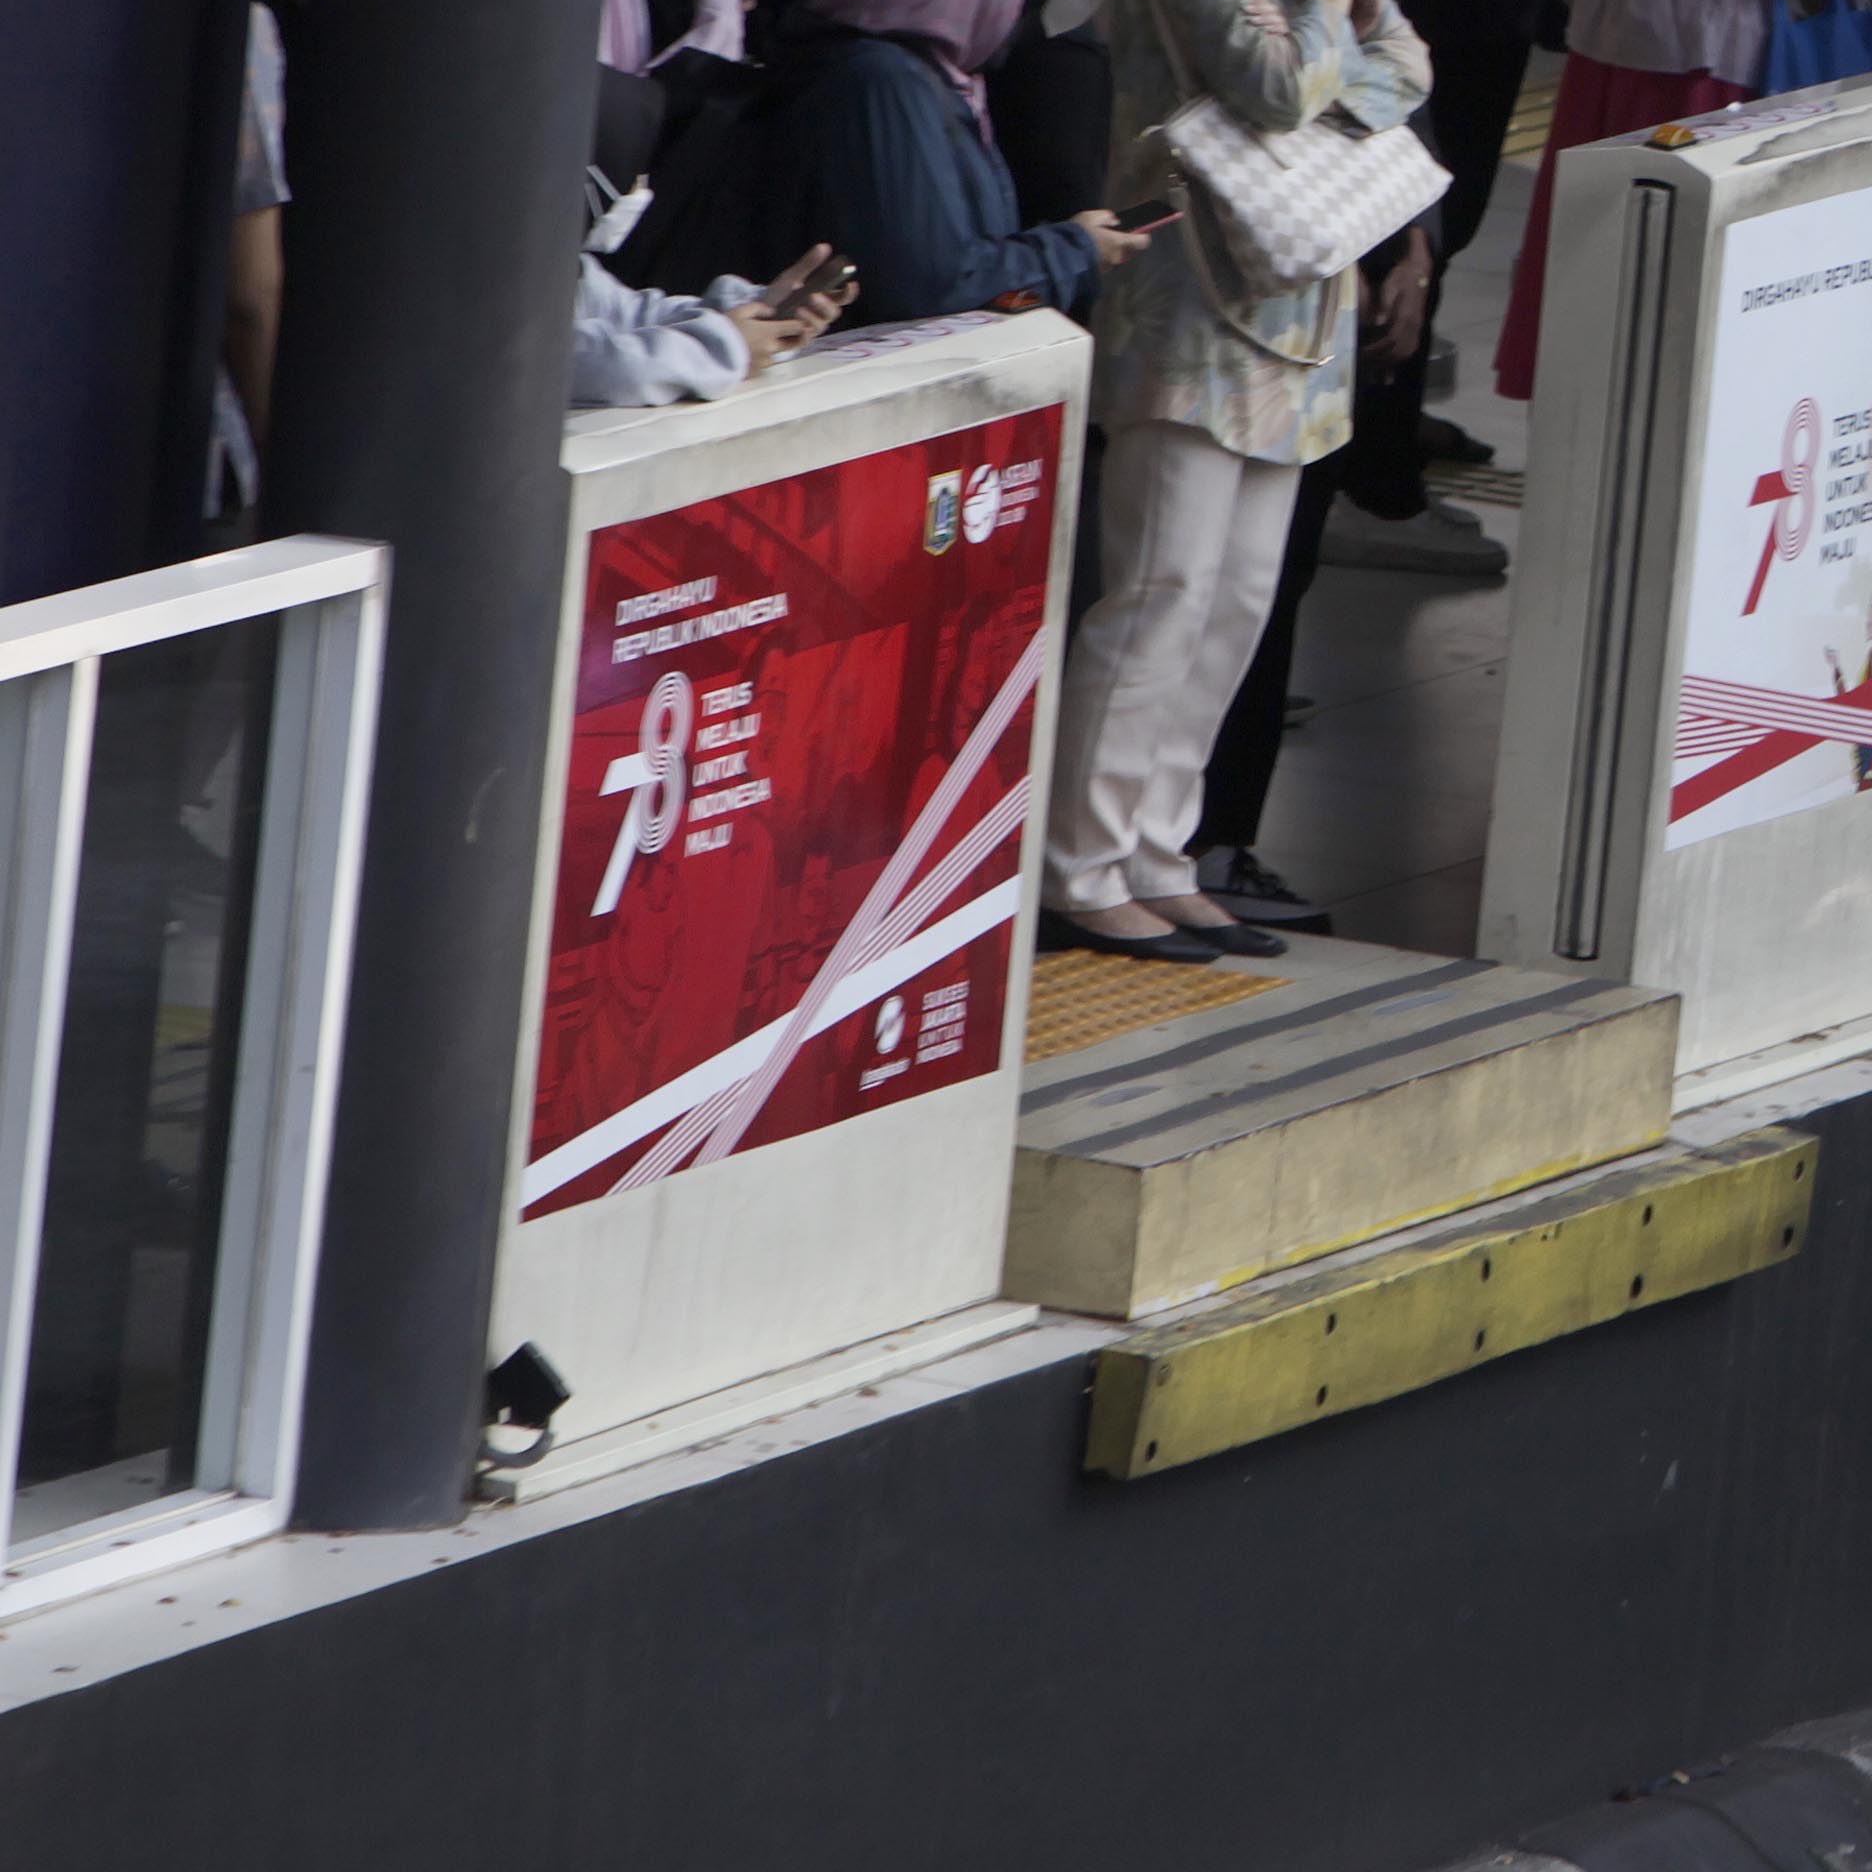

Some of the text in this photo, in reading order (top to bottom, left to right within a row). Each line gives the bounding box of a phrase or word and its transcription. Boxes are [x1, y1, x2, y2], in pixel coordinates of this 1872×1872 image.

[1742, 271, 1820, 313] DIRGAHAYU
[1740, 396, 1822, 618] 78
[1825, 470, 1871, 503] UNTUK
[1819, 536, 1858, 566] MAJU
[615, 575, 718, 627] DIRGAHAYU
[611, 592, 789, 665] REPUBLIK INDONESIA
[700, 681, 754, 718] TERUS
[694, 712, 762, 753] MELAJU
[692, 750, 750, 788] UNTUK
[590, 670, 695, 918] 78
[687, 777, 773, 823] INDONESIA
[683, 822, 734, 858] MAJU
